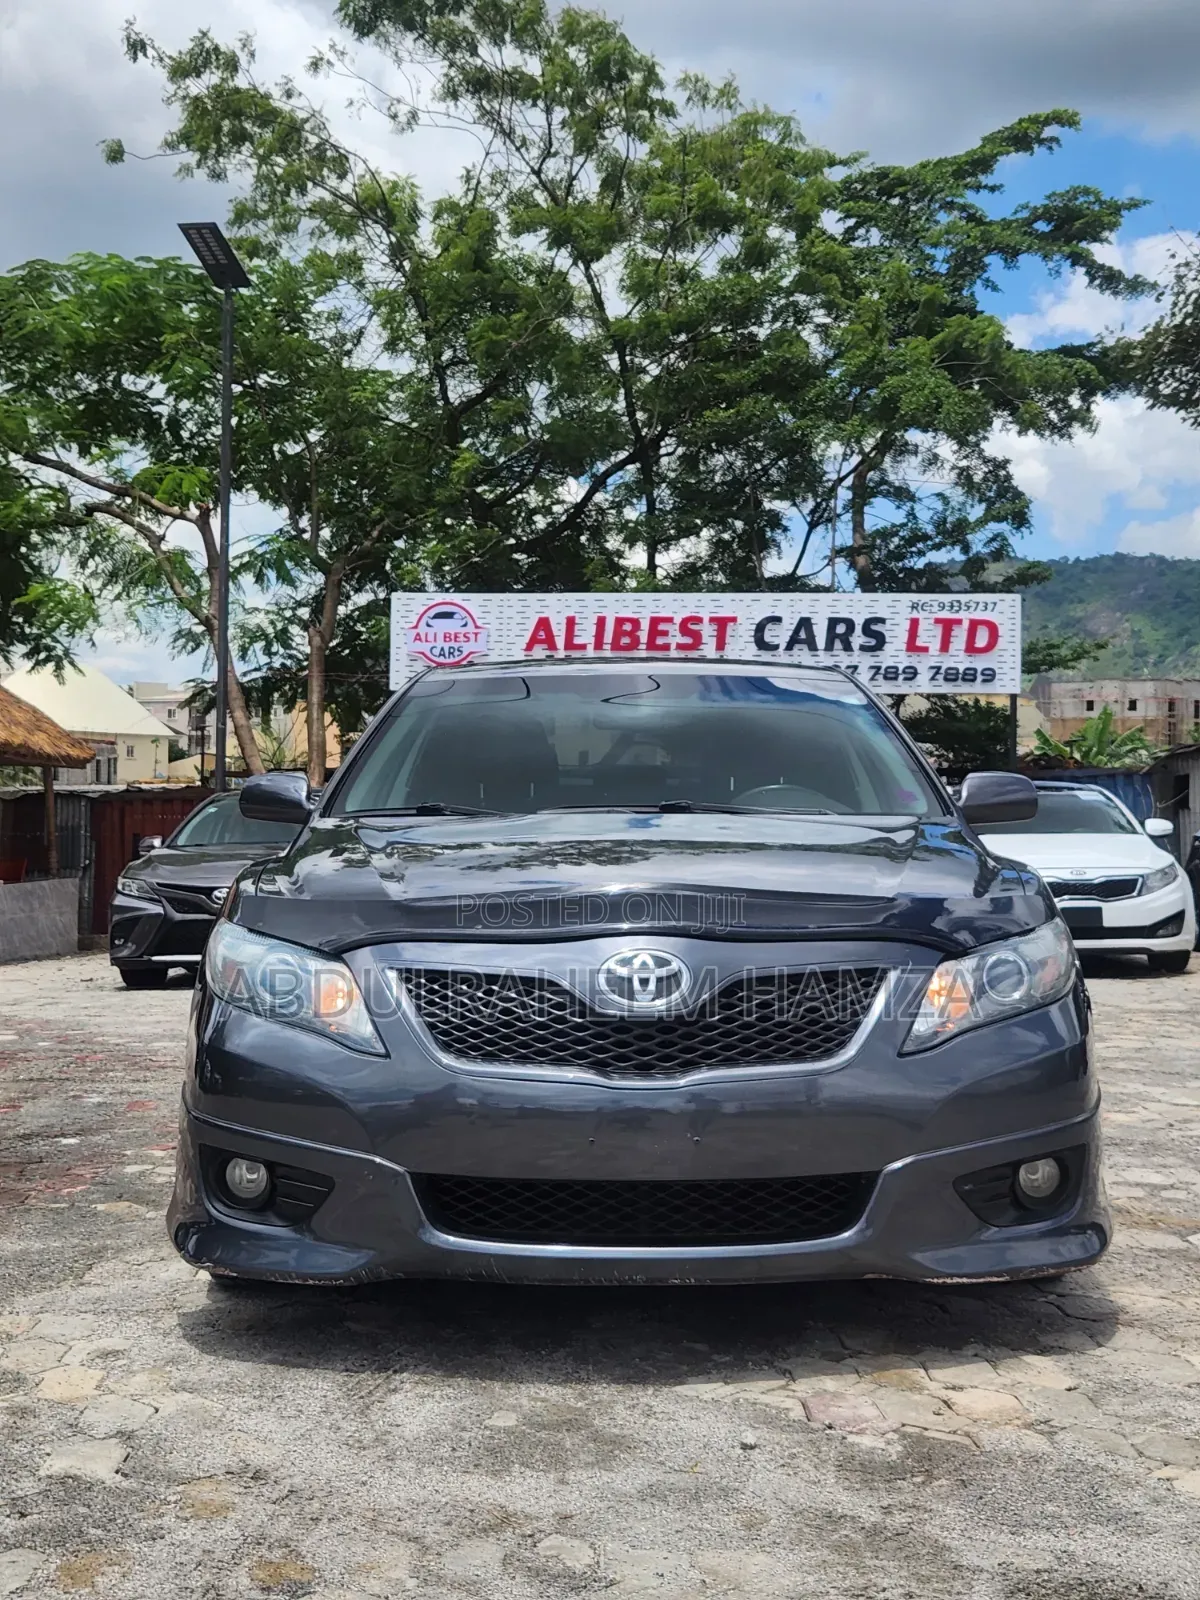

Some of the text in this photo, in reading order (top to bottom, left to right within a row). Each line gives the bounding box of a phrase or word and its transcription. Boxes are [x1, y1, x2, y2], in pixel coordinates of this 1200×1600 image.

[412, 631, 482, 643] ALI BEST
[524, 614, 1000, 654] ALIBEST CARS LTD
[429, 645, 464, 659] CARS
[867, 665, 919, 682] 789
[928, 665, 997, 684] 7889
